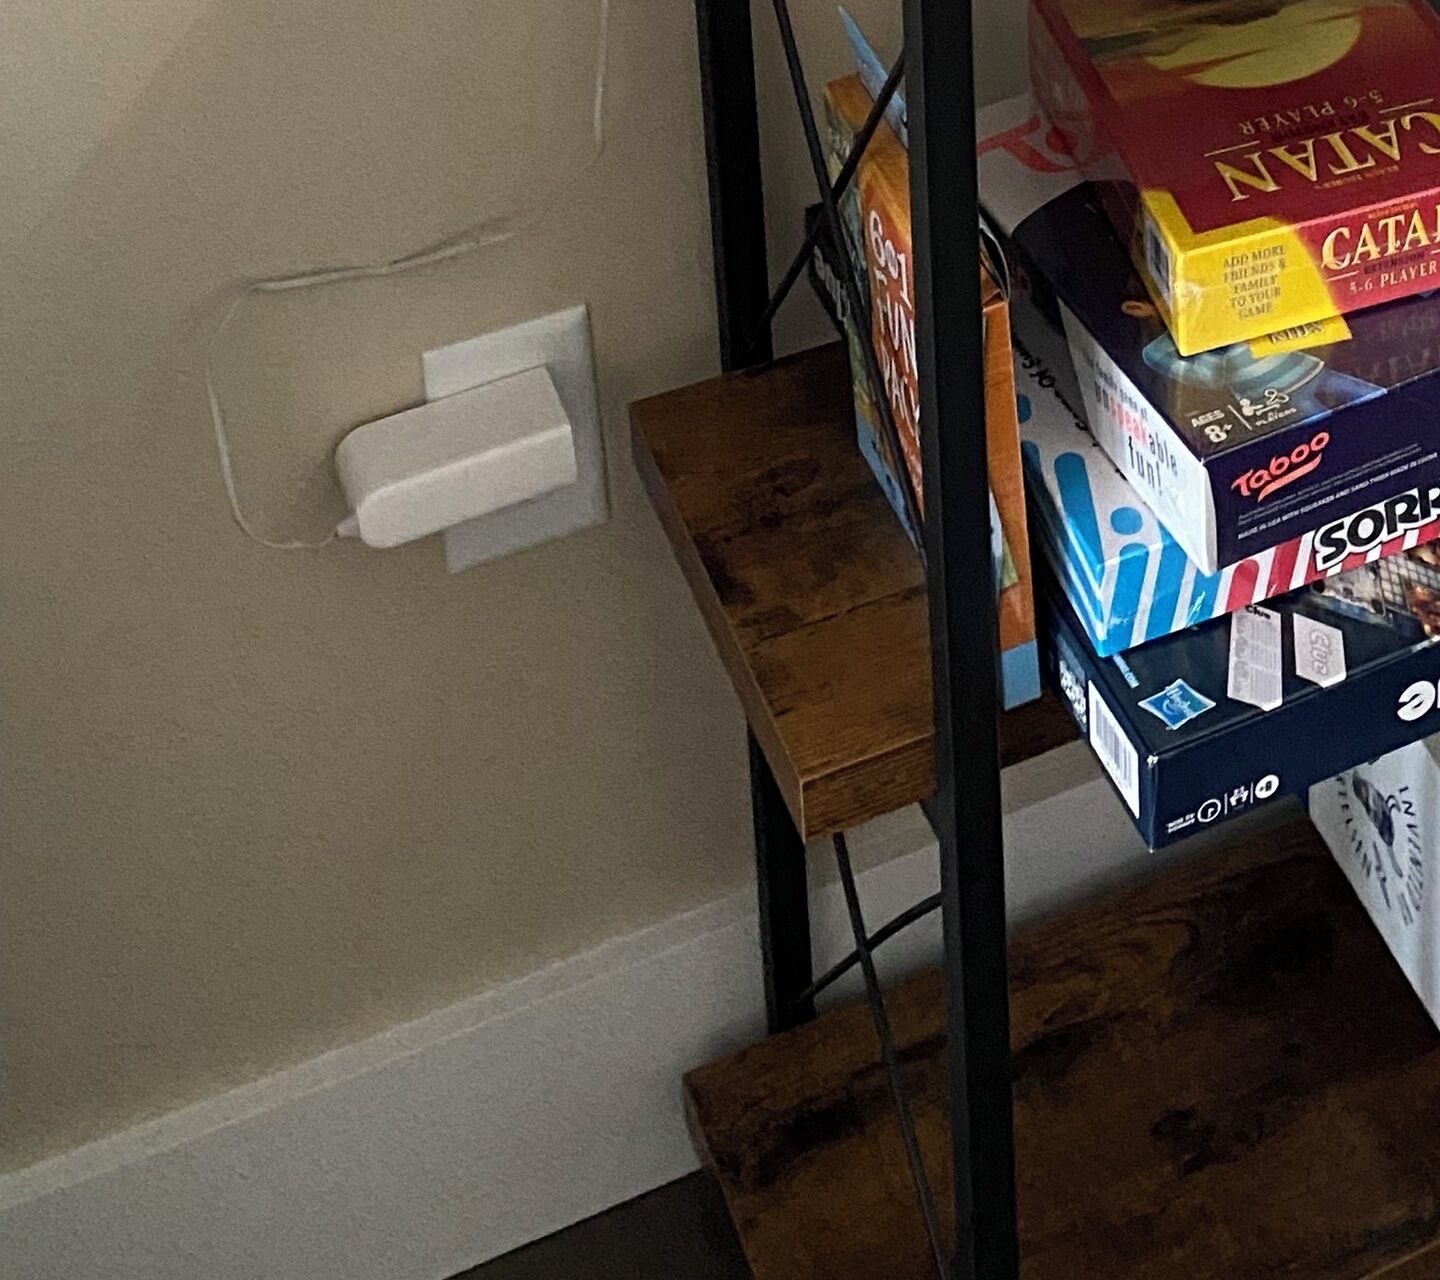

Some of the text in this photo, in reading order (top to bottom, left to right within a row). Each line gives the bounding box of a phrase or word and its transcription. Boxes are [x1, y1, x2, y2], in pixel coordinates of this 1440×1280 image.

[1238, 99, 1336, 137] PLAYER
[1379, 260, 1438, 288] PLAYER
[1191, 409, 1225, 428] AGES
[1204, 423, 1233, 444] 8+
[1231, 431, 1331, 497] Taboo
